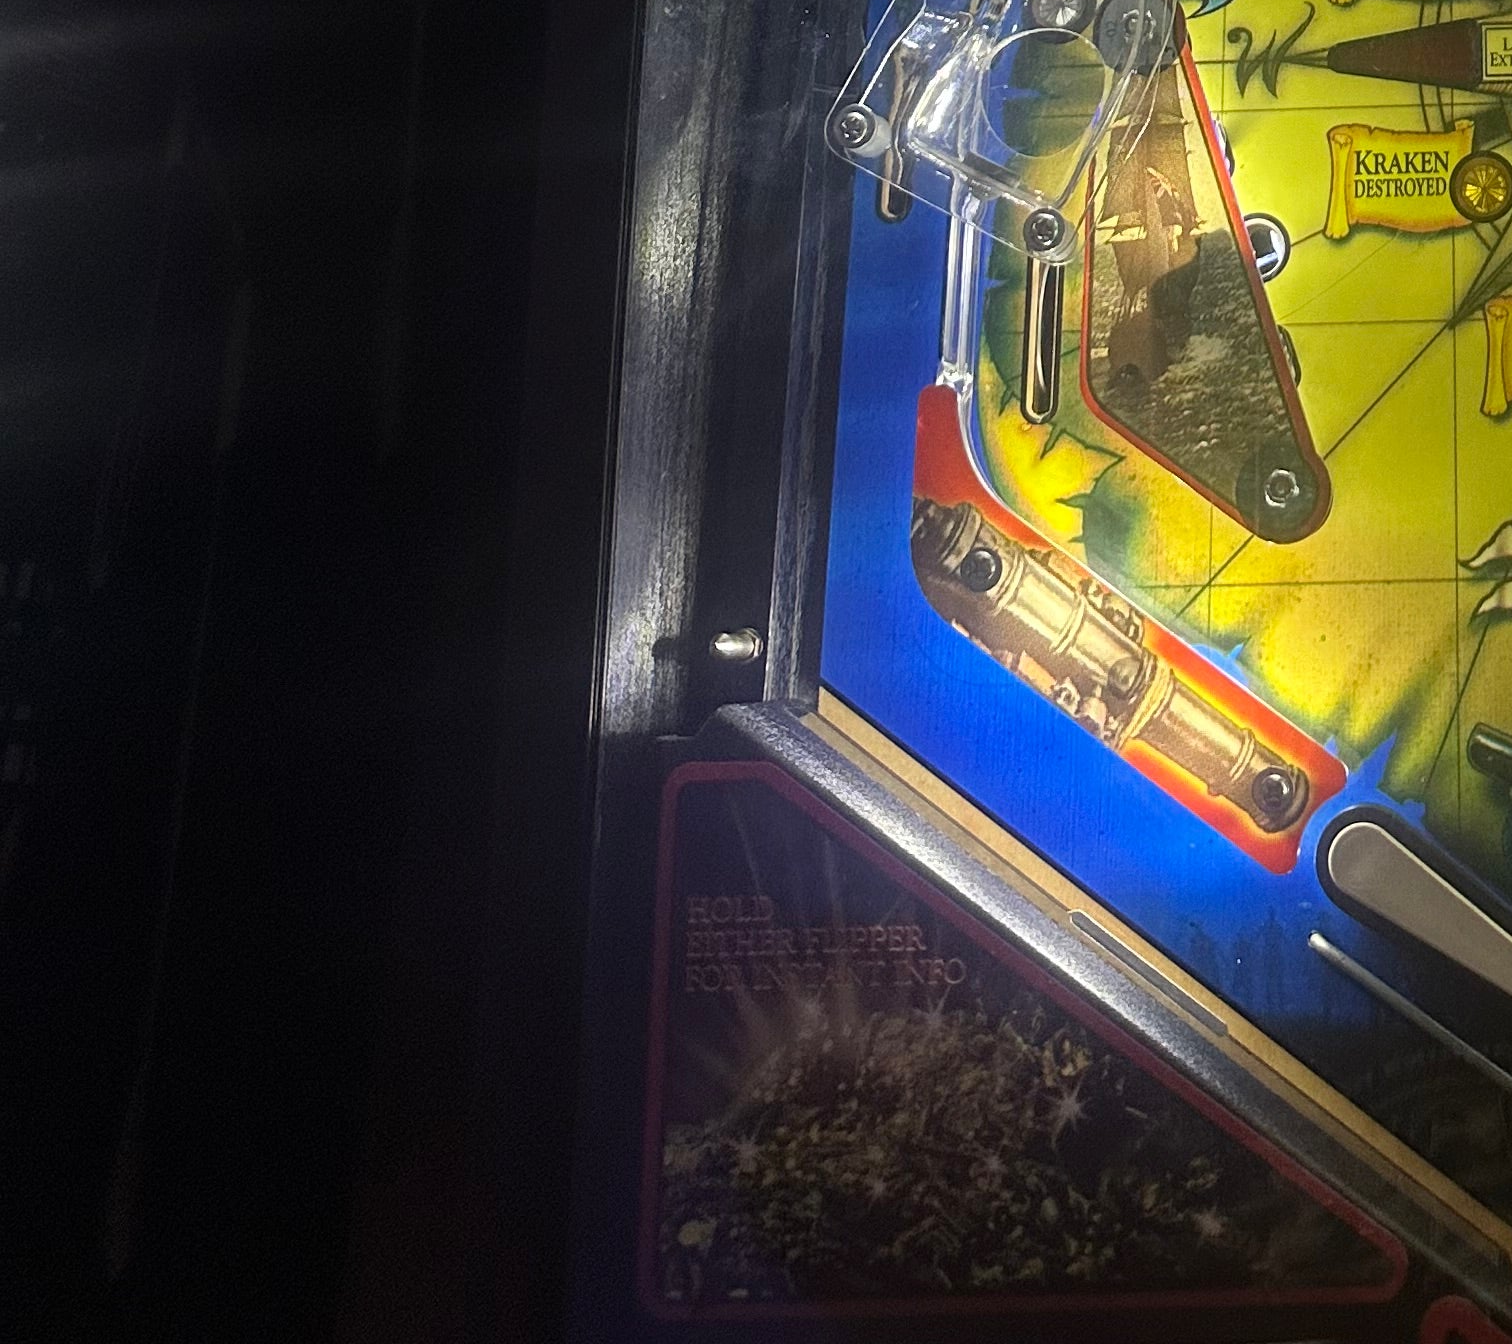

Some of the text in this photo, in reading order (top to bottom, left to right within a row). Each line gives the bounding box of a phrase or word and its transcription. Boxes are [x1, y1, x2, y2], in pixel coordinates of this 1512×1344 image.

[1354, 150, 1450, 175] KRAKEN
[1354, 177, 1447, 199] DESTROYED
[686, 895, 774, 924] HOLD
[687, 925, 927, 956] EITHER FLIPPER
[687, 965, 740, 992] FOR
[893, 958, 967, 985] INFO
